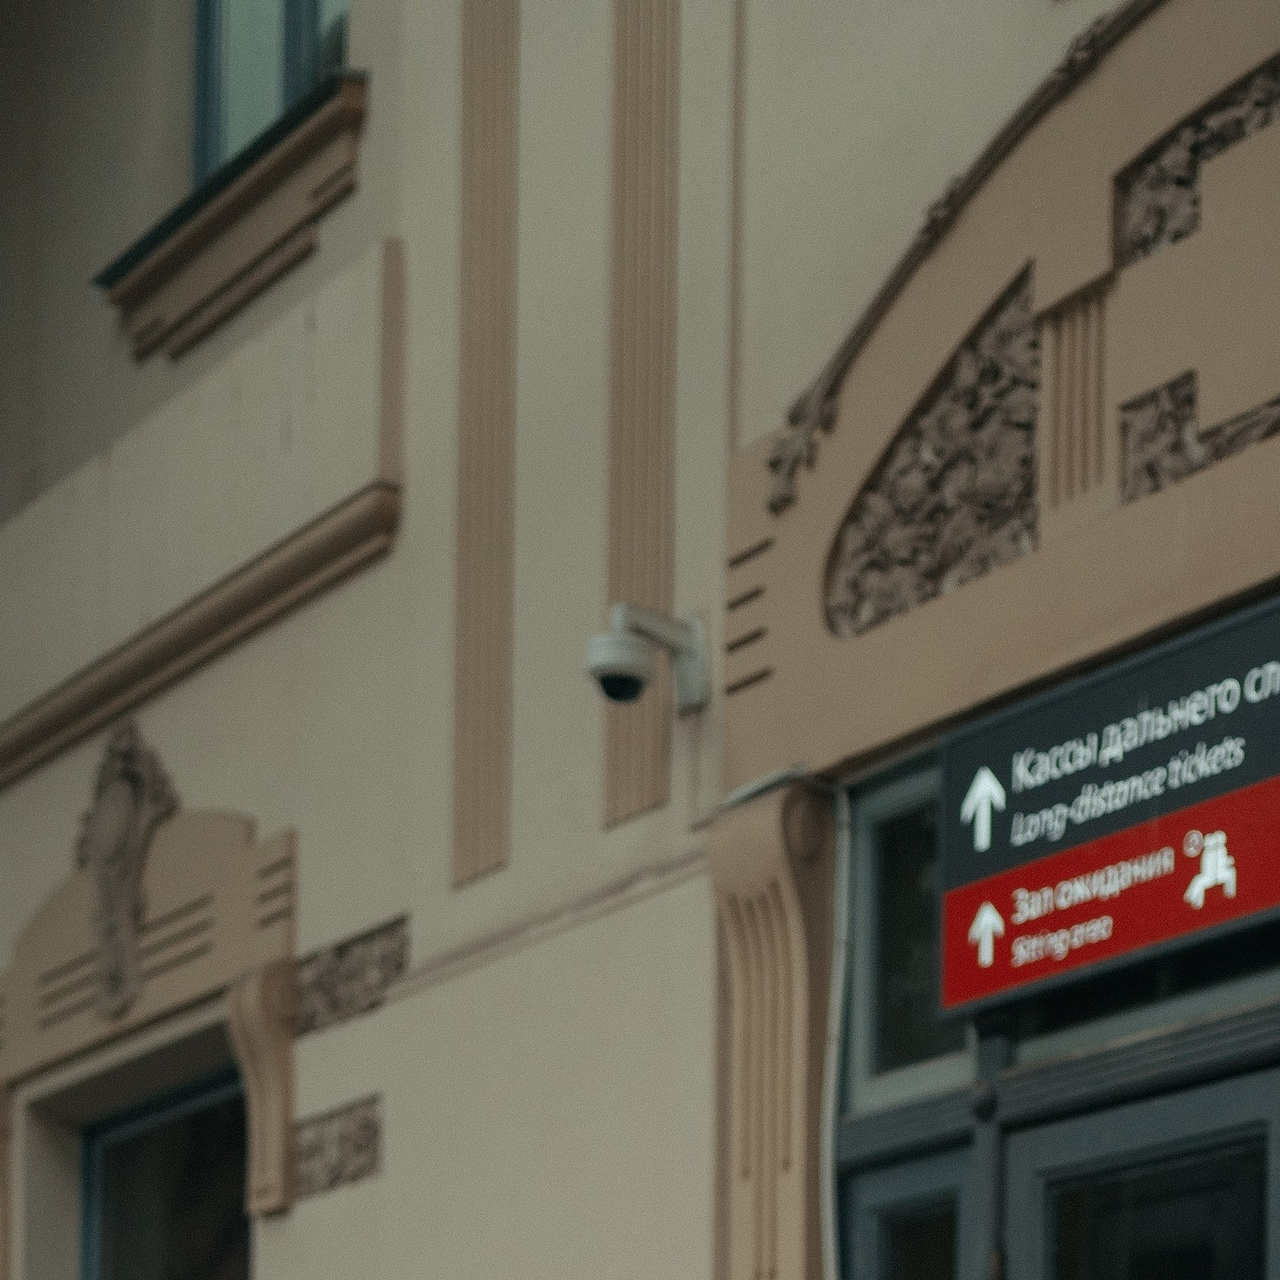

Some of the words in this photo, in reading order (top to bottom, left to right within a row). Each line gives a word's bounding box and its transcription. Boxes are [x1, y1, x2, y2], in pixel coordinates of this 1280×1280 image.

[1011, 731, 1097, 793] Кассы
[1098, 678, 1241, 767] дальнего
[1167, 735, 1246, 790] tickets
[1011, 887, 1054, 925] Зал
[1055, 846, 1175, 911] ожидания
